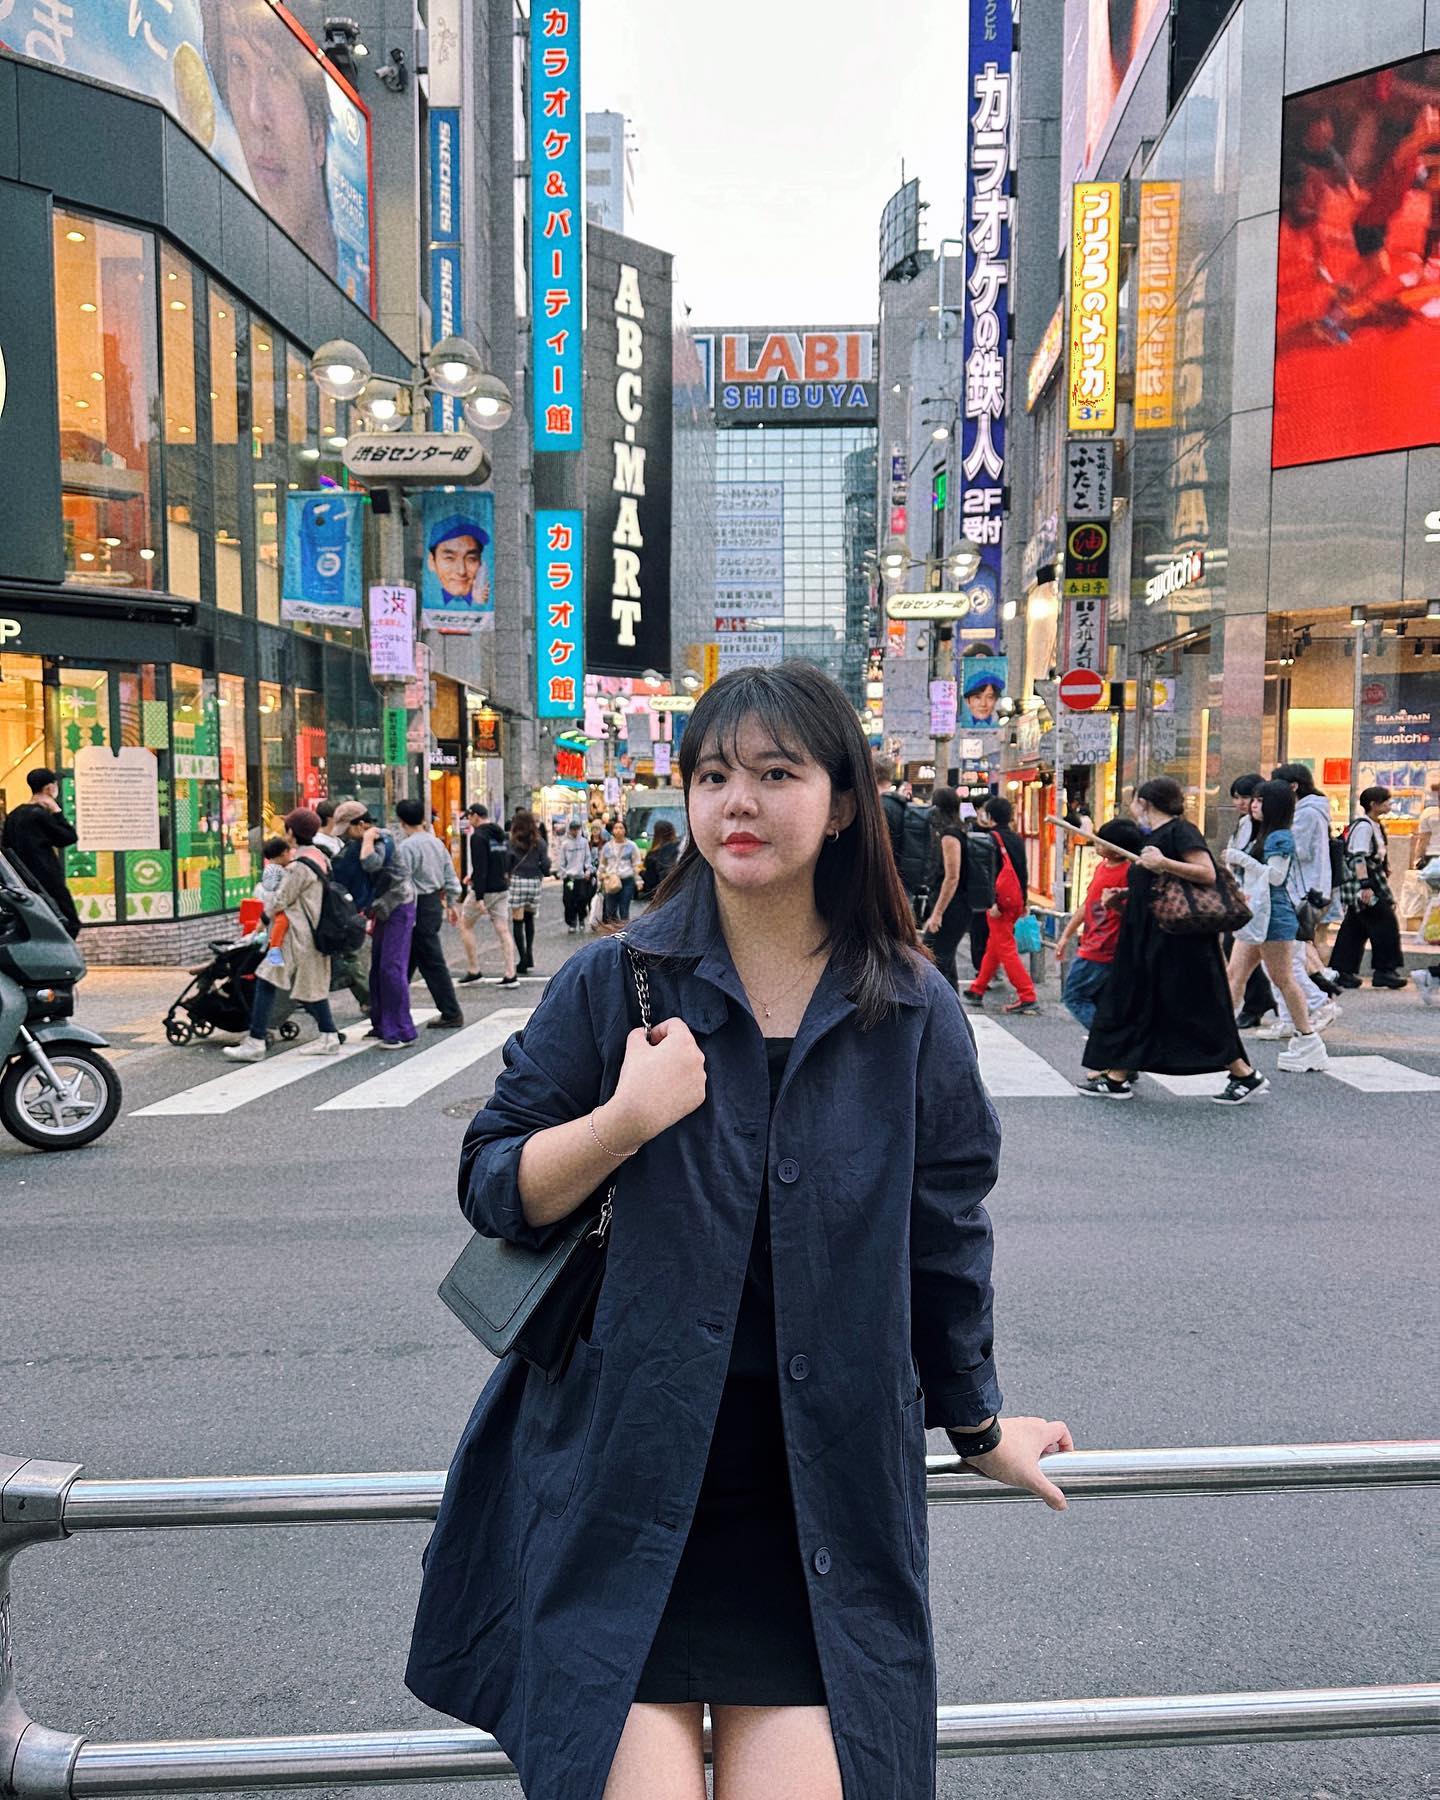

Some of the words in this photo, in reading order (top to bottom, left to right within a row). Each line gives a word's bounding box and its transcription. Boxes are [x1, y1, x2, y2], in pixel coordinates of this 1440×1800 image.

[439, 120, 452, 233] SKECHERS
[543, 8, 573, 436] カラオケ&パーティー館
[961, 62, 1011, 481] カラオケの鉄人
[1080, 189, 1112, 399] プリクラのメッカ
[722, 332, 873, 383] LABI
[723, 384, 869, 408] SHIBUYA
[352, 445, 473, 462] 渋谷センター街
[611, 263, 646, 647] ABC-MART
[1070, 447, 1096, 511] ふたご
[962, 515, 1003, 545] 受付
[963, 487, 1003, 514] 2F
[1145, 550, 1194, 606] swatch
[548, 523, 577, 702] カラオケ館
[1374, 732, 1421, 745] swatch
